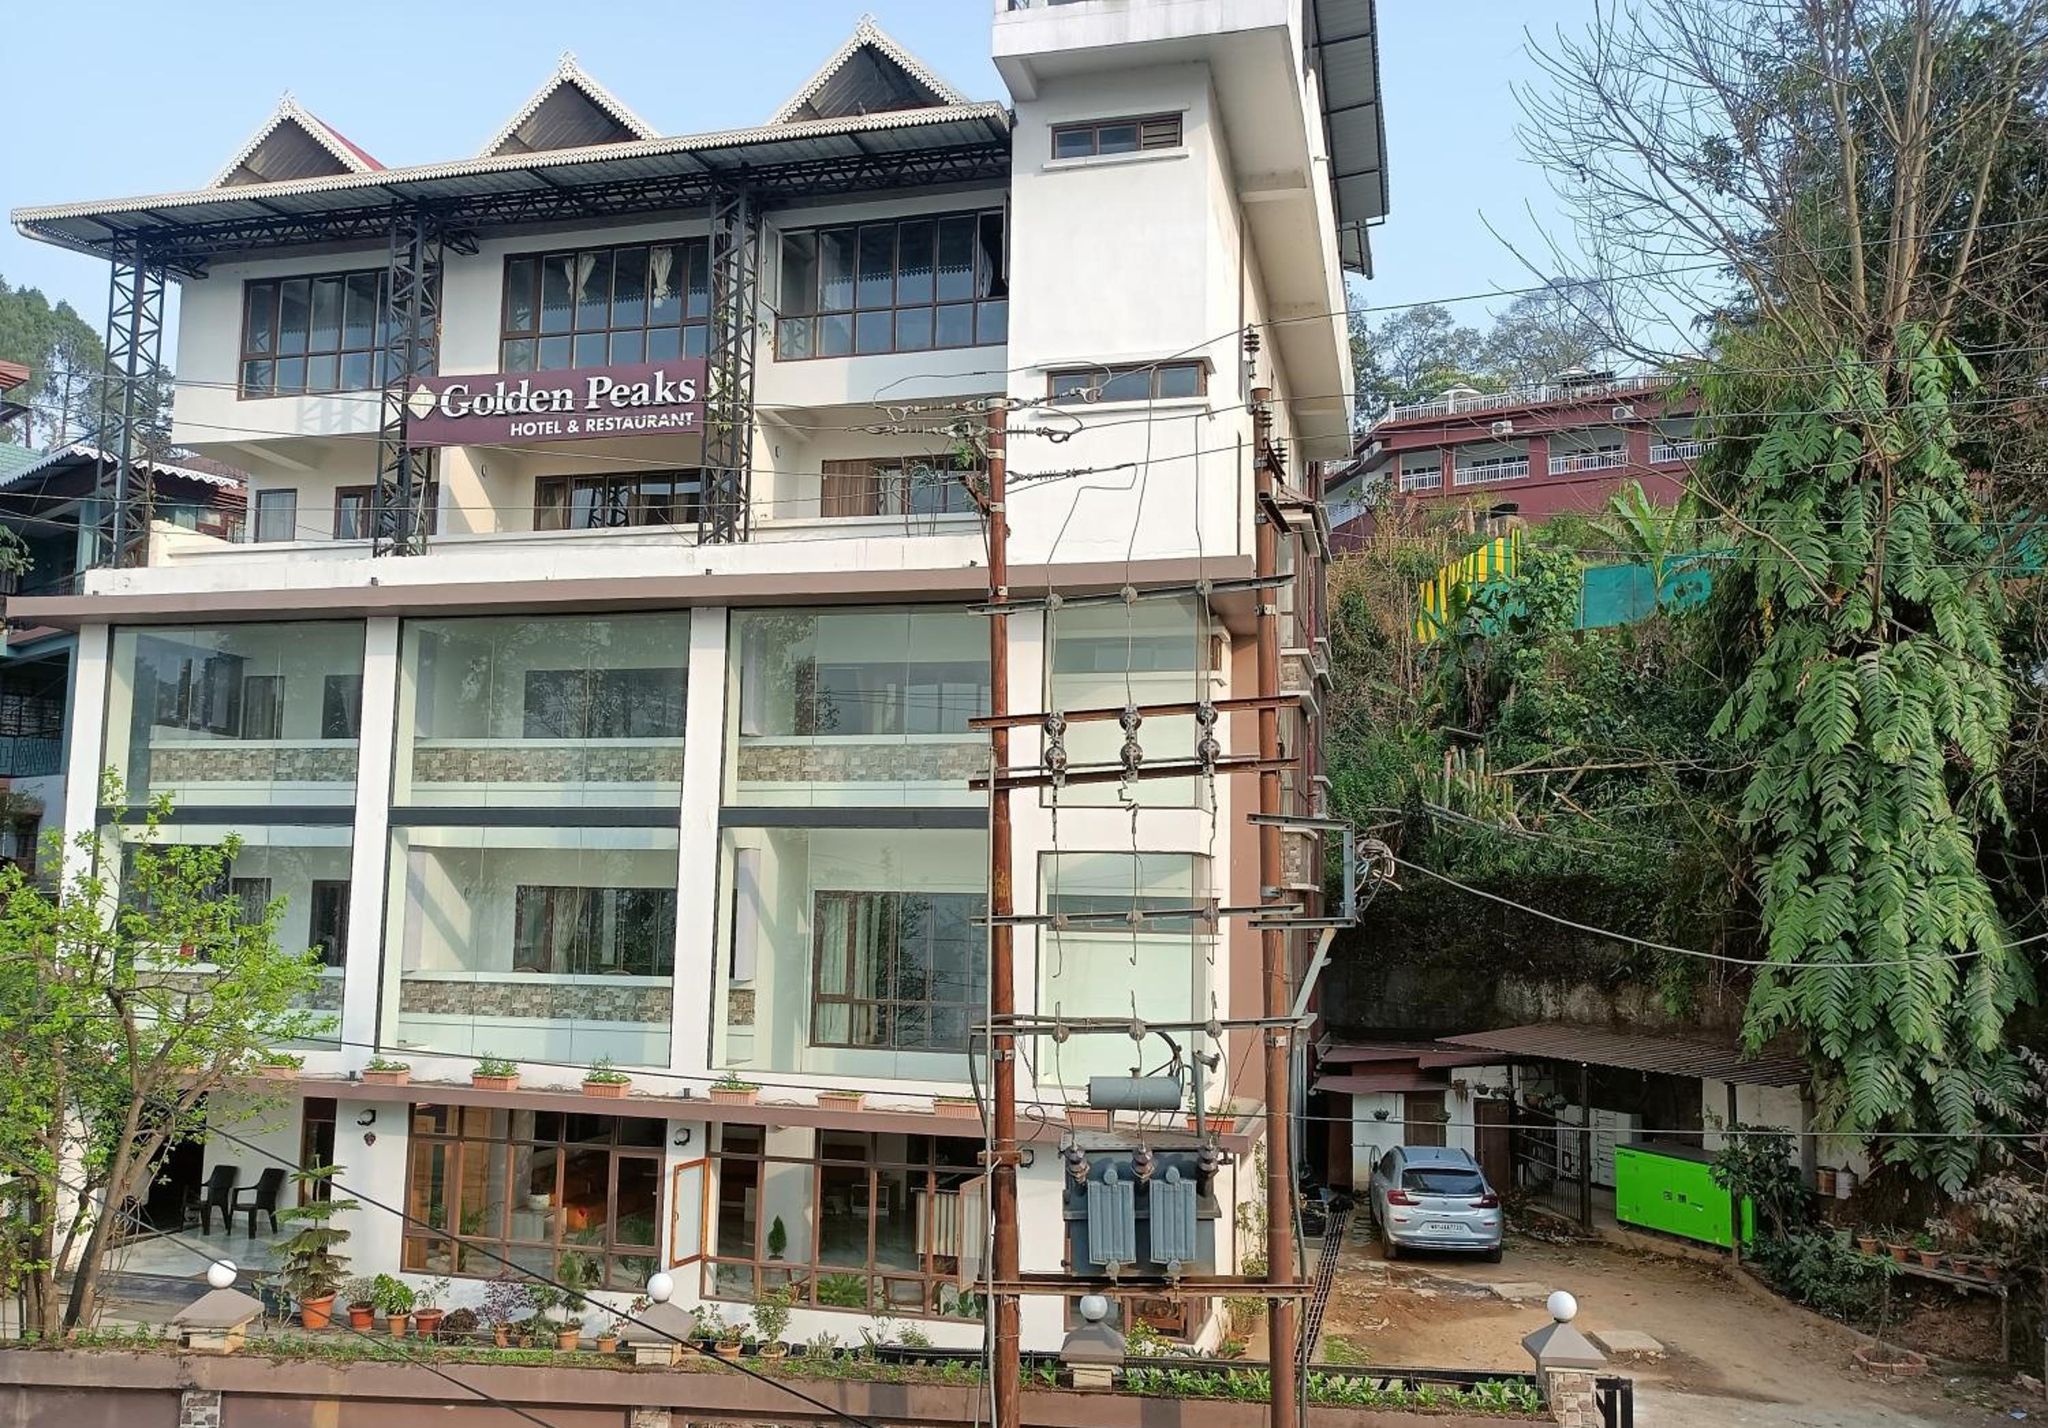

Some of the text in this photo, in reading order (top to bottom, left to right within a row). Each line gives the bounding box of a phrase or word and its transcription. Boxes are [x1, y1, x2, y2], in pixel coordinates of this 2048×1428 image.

[440, 370, 696, 418] Golden Peaks
[510, 412, 695, 436] HOTEL & RESTAURANT
